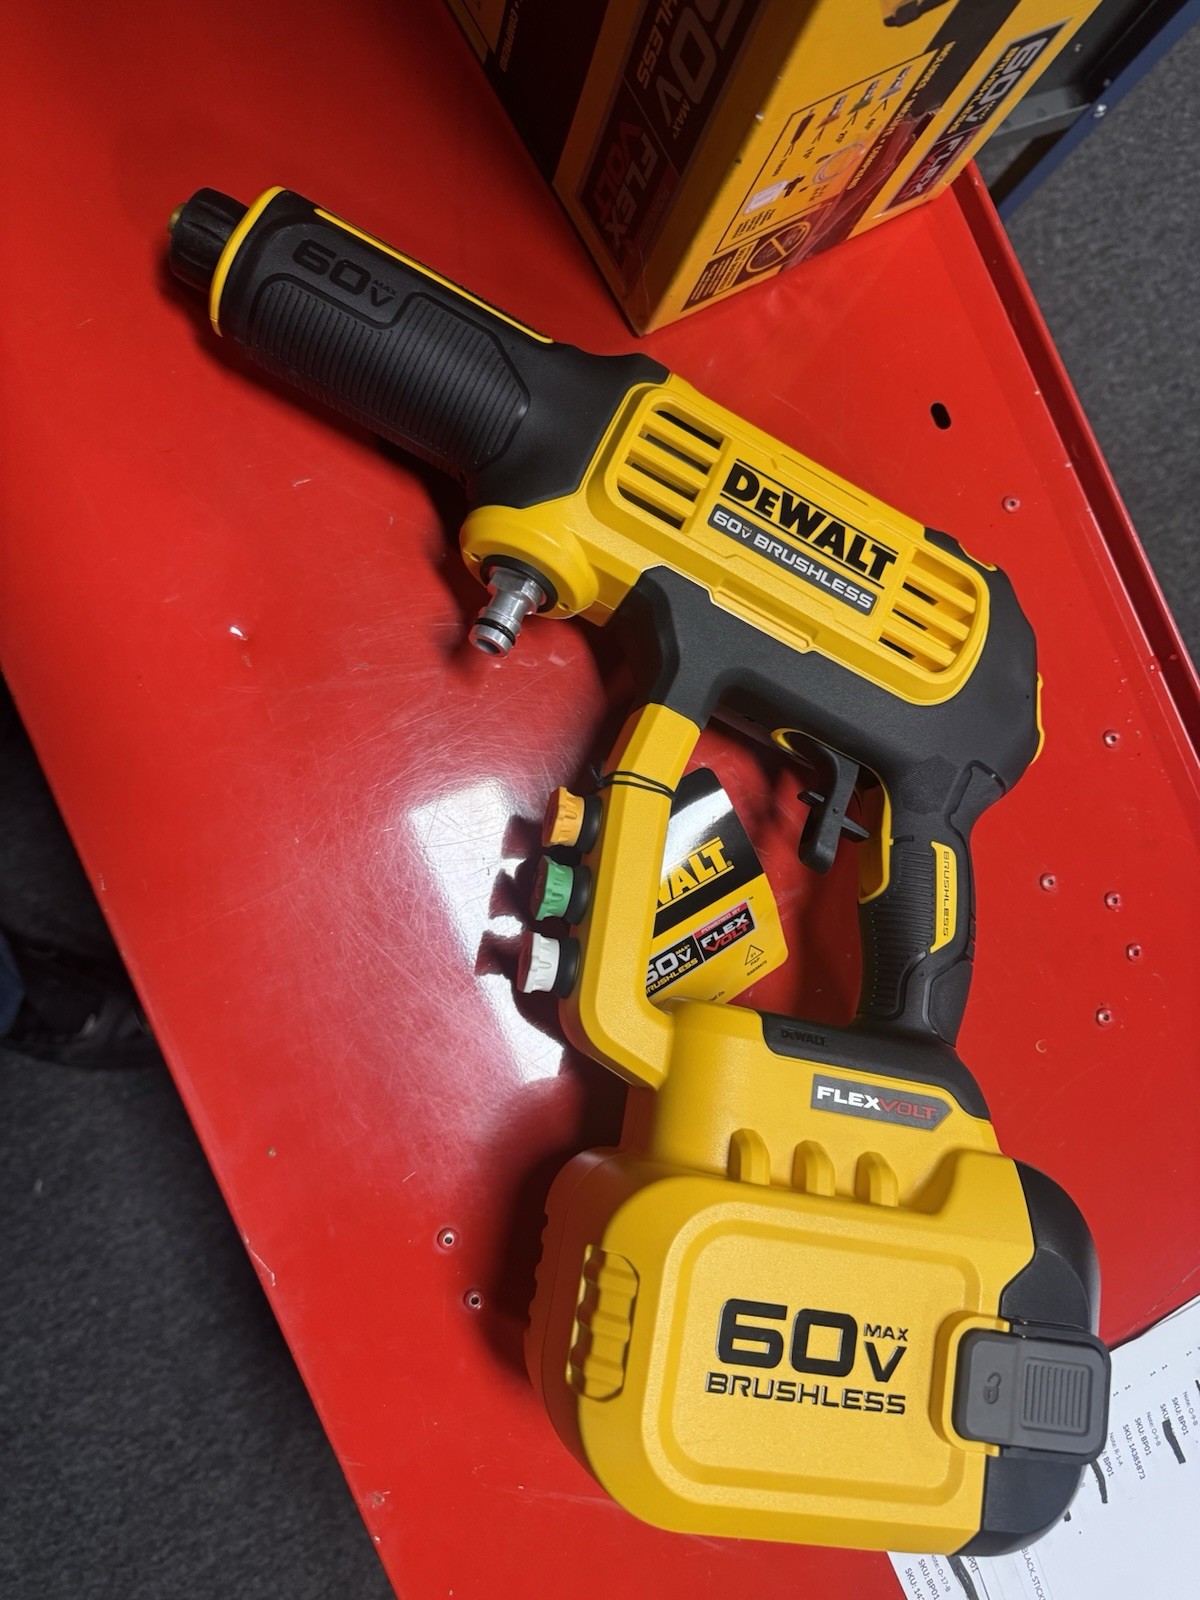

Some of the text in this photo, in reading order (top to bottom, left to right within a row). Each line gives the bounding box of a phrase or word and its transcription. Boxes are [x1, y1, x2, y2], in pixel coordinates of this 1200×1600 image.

[605, 131, 658, 242] FLEX
[292, 238, 394, 308] 60V
[753, 534, 874, 609] BRUSHLESS
[700, 912, 748, 948] FLEX
[705, 922, 750, 952] VOLT
[646, 958, 698, 994] RUSHLESS
[716, 1298, 908, 1382] 60V
[863, 1323, 909, 1342] MAX
[706, 1372, 906, 1415] BRUSHLESS
[1172, 1397, 1189, 1435] SKU: BP01
[1123, 1424, 1146, 1480] SKU: 14385873
[1135, 1418, 1152, 1456] SKU: BP01
[1103, 1456, 1114, 1477] BP01
[905, 1567, 917, 1589] SKU:
[918, 1558, 940, 1600] SKU: BP01
[938, 1568, 951, 1593] O-17-B
